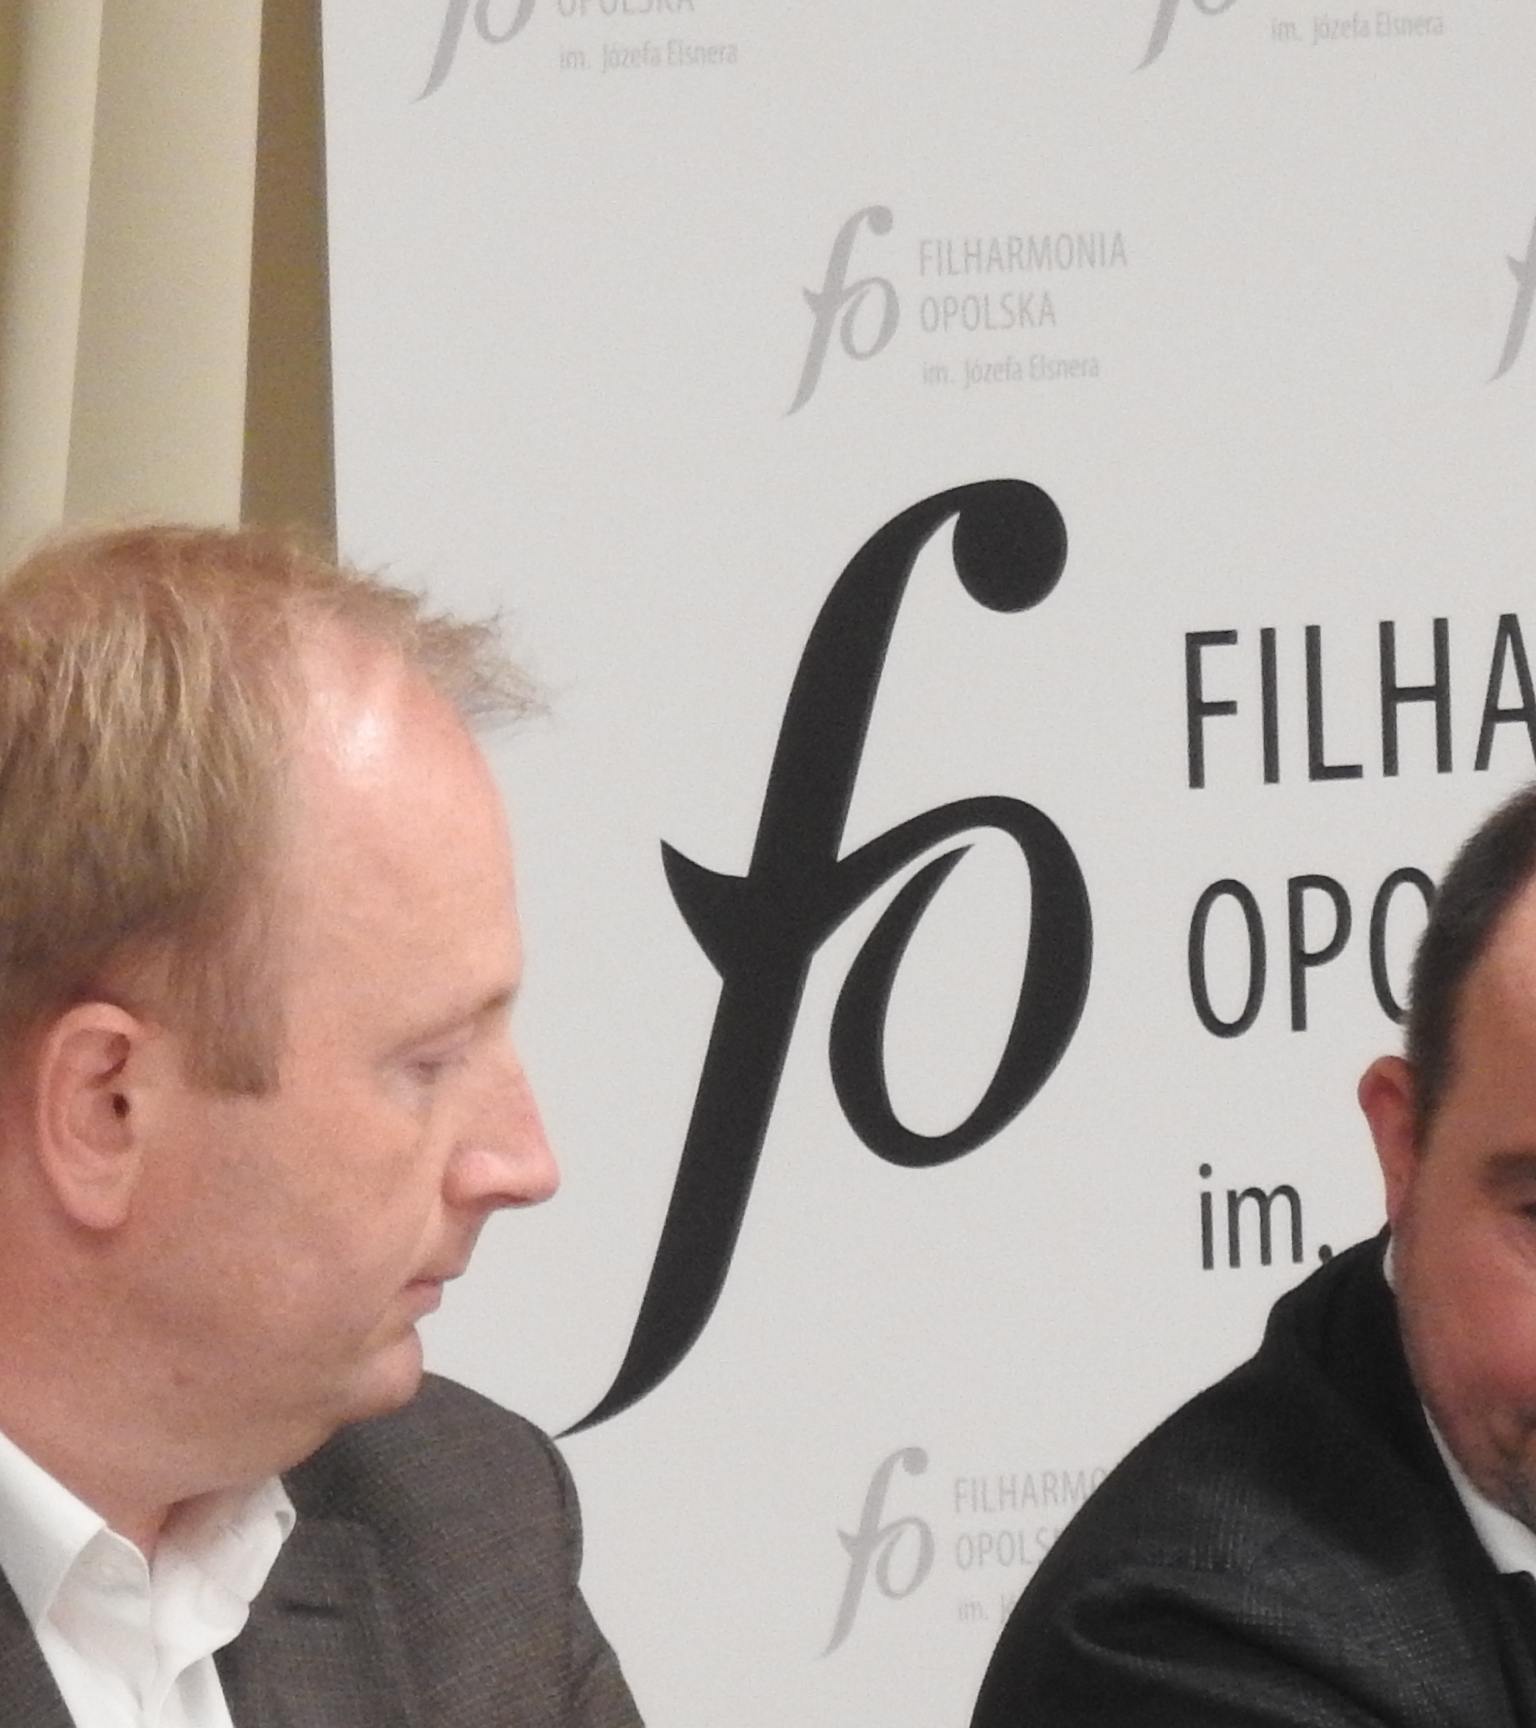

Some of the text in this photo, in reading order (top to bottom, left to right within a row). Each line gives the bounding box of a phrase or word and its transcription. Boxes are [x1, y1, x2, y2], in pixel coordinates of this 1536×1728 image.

[918, 230, 1128, 277] FILHARMONIA
[919, 291, 1057, 333] OPOLSKA
[1198, 1162, 1334, 1271] im.
